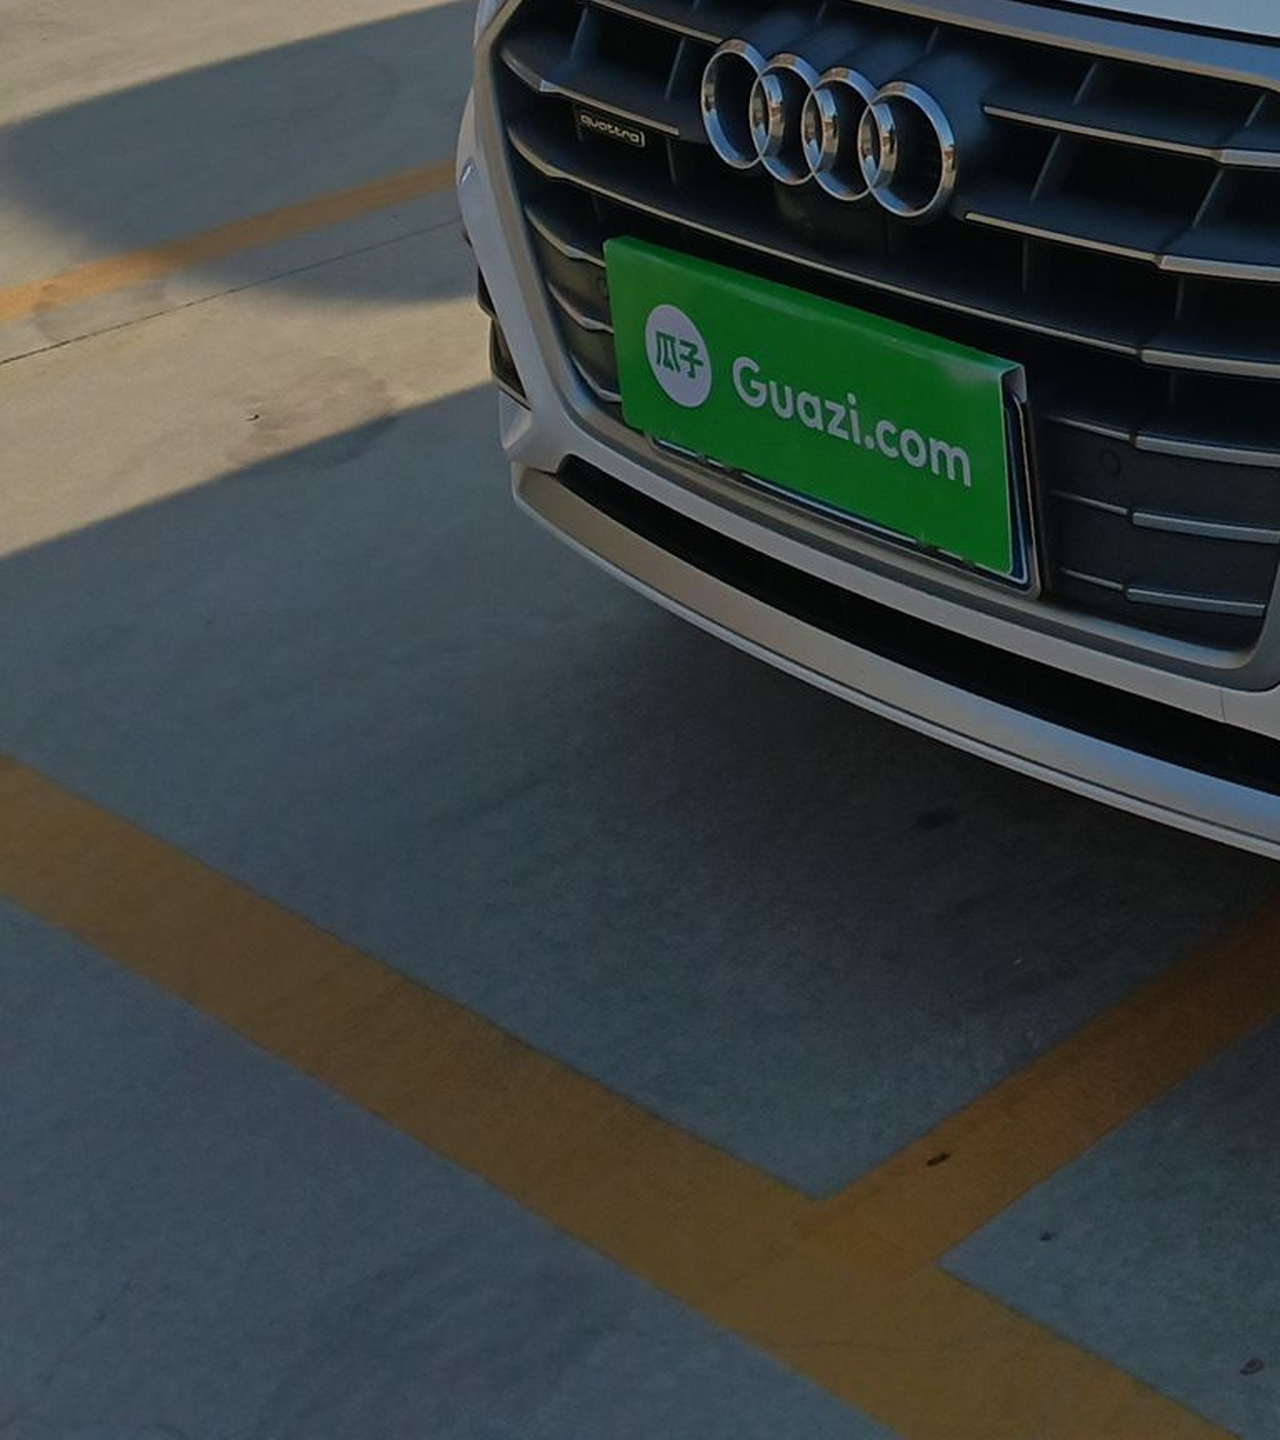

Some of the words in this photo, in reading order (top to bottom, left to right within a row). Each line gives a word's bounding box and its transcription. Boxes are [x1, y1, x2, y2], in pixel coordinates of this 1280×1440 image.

[580, 114, 640, 143] quattro
[654, 330, 704, 380] 瓜子
[732, 356, 973, 488] Guazi.com
